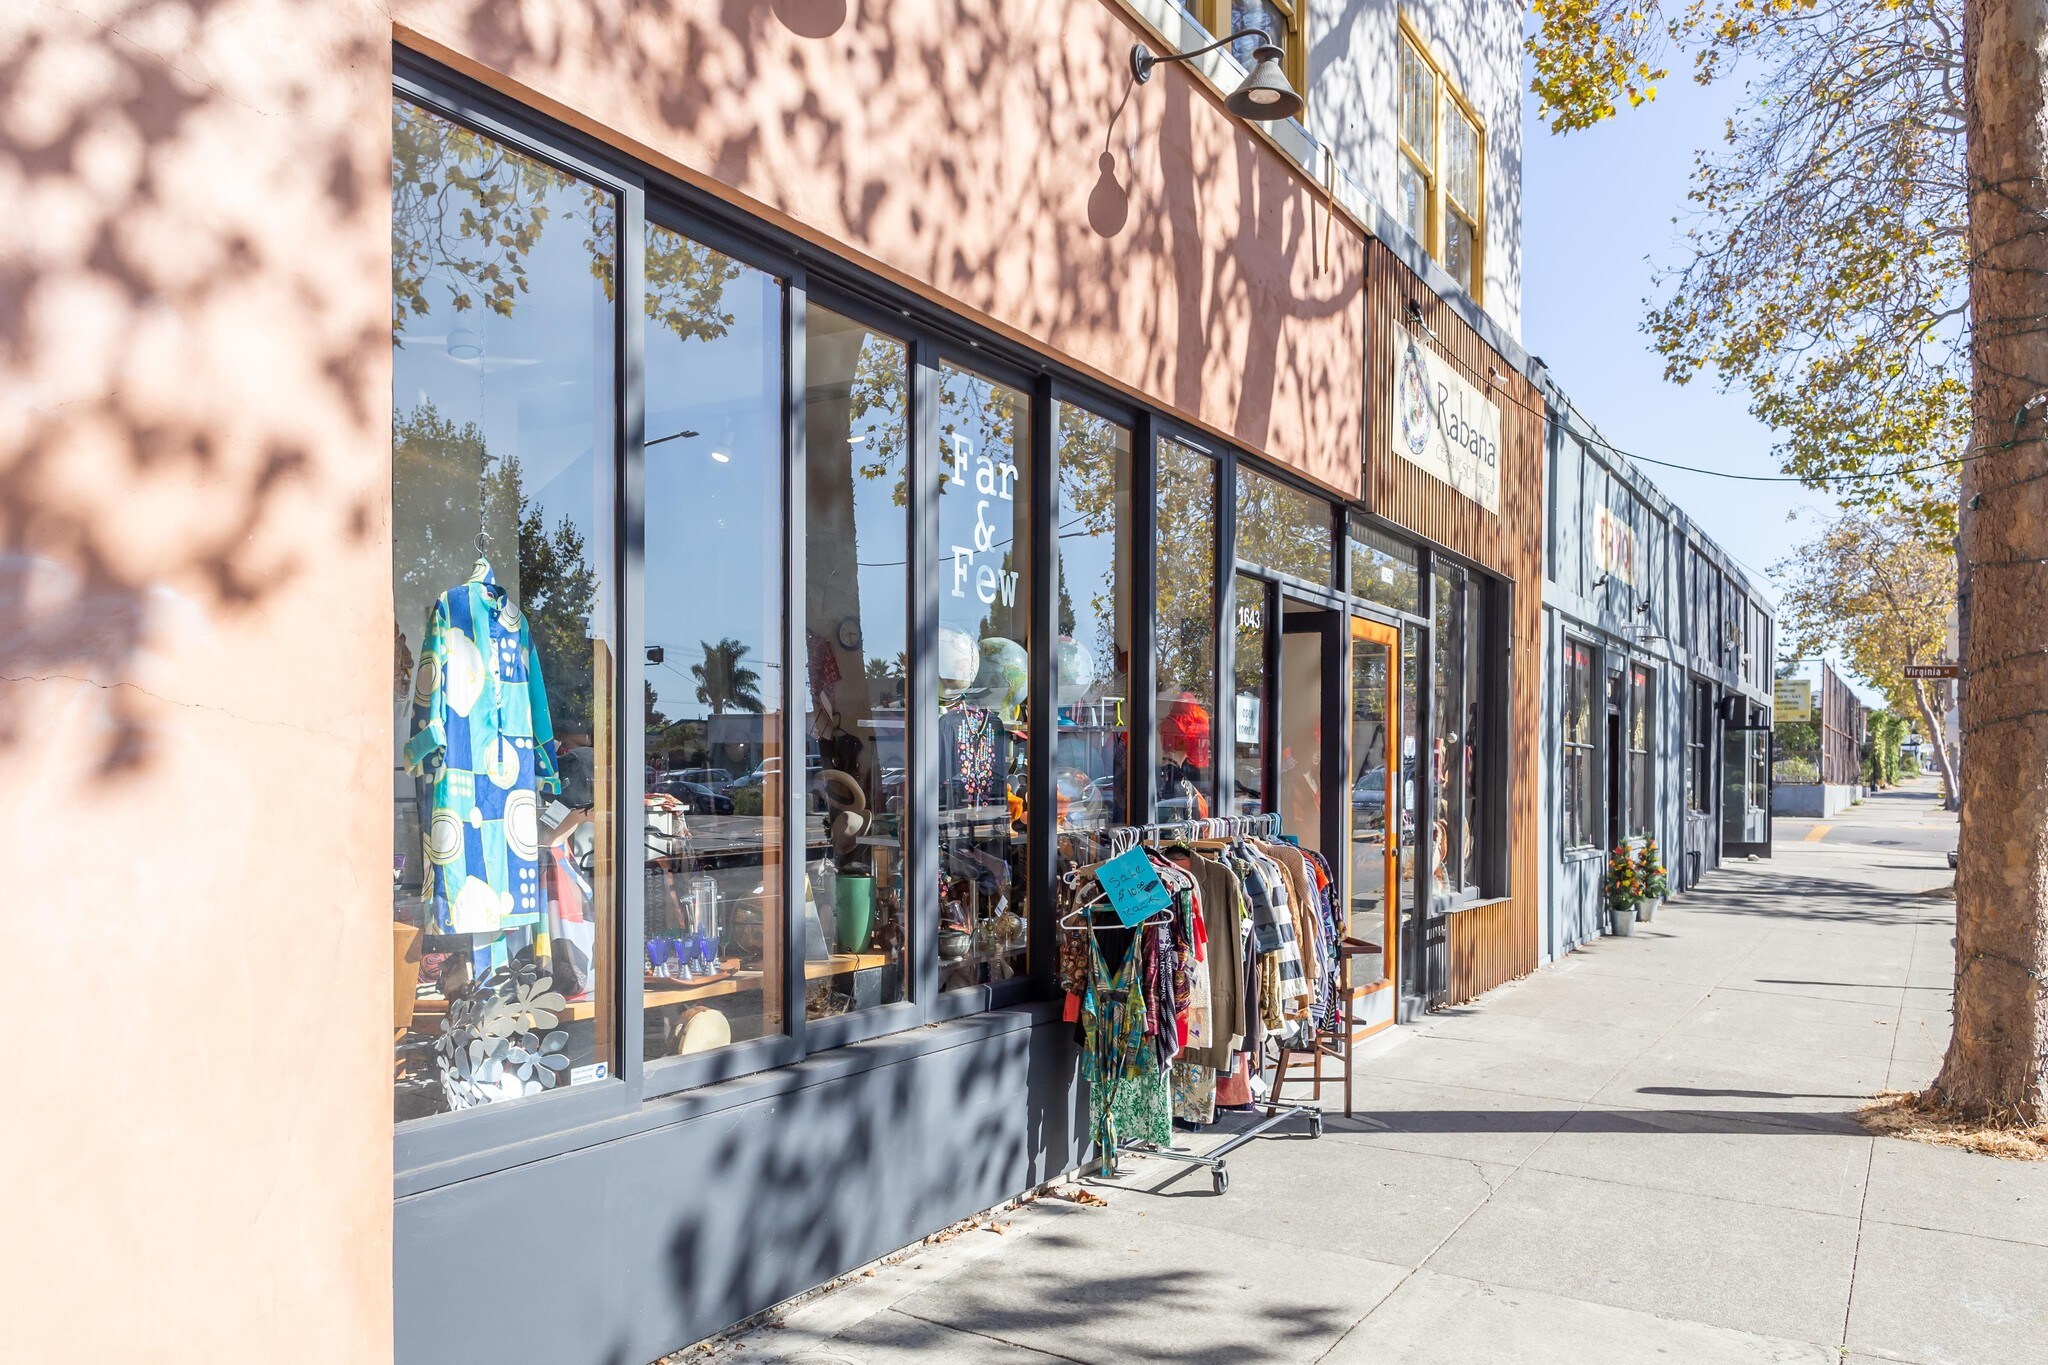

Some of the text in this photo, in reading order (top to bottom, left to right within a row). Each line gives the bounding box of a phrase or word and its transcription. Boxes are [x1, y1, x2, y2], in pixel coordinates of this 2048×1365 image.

[1436, 381, 1496, 469] Rabana
[951, 432, 1019, 501] Far
[974, 500, 996, 553] &
[951, 544, 1019, 608] Few
[1238, 606, 1260, 629] 1643
[1906, 667, 1941, 678] Virginia
[1123, 893, 1160, 918] Rack
